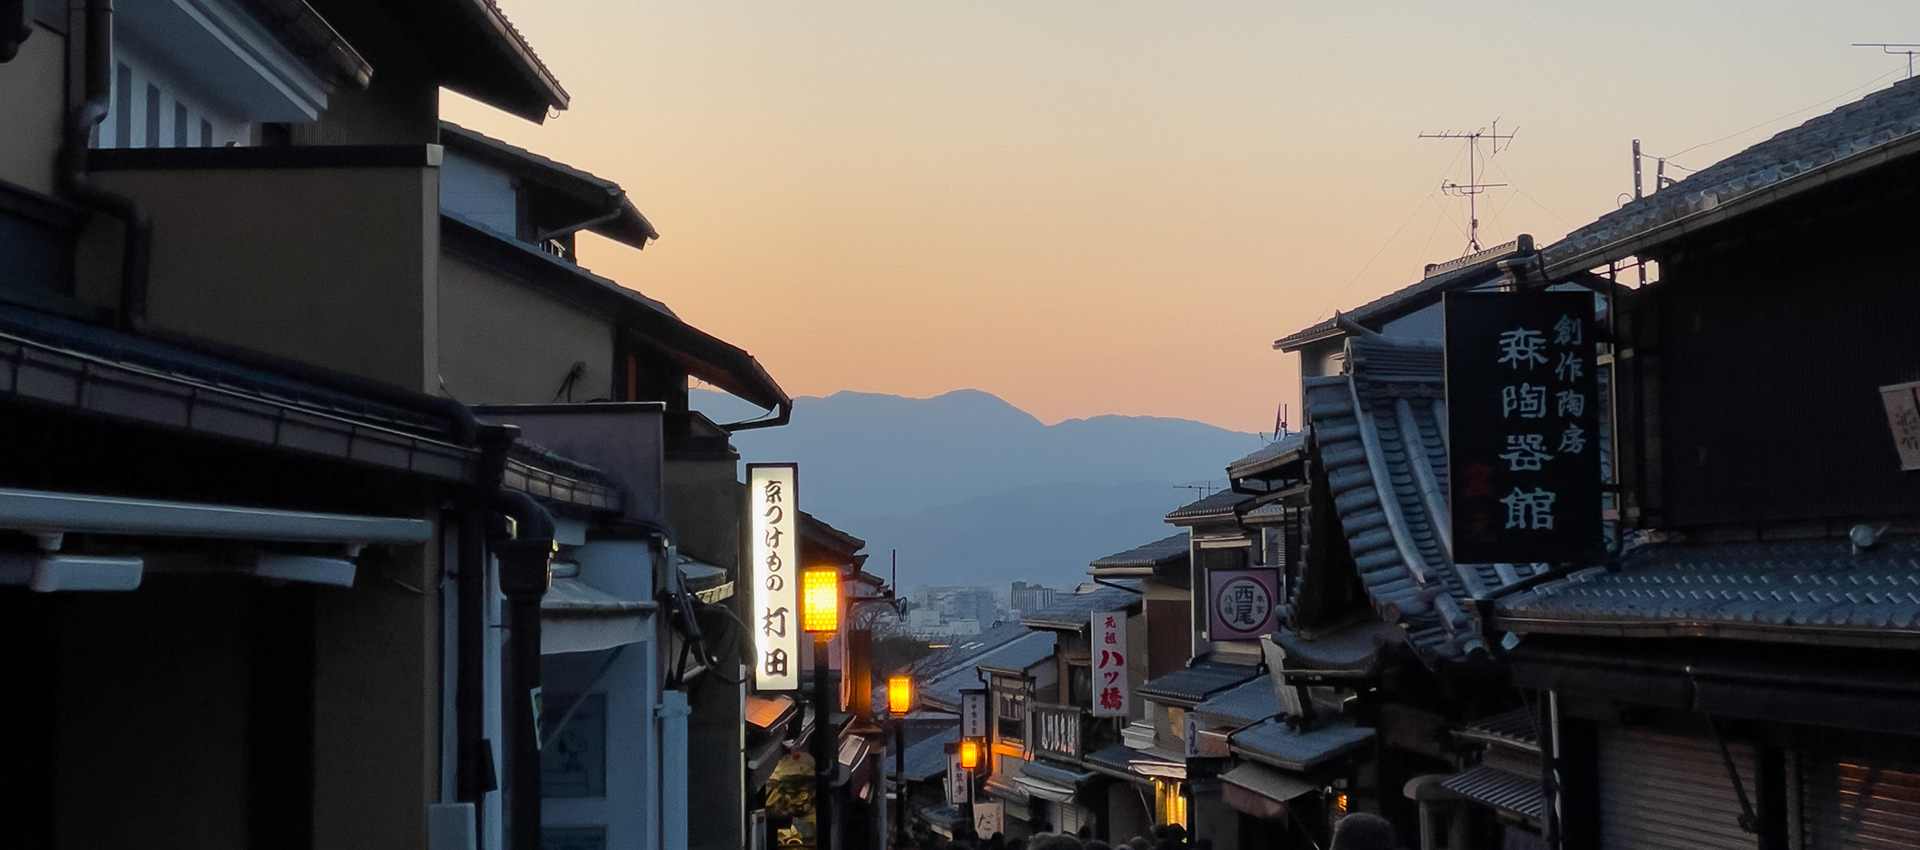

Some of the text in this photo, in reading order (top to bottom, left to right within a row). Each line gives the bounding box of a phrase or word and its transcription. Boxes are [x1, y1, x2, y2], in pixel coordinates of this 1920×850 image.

[1497, 327, 1557, 530] 森陶器館
[1553, 314, 1587, 454] 創作陶房
[763, 481, 790, 677] 京つけもの 打田
[1233, 585, 1255, 624] 西尾
